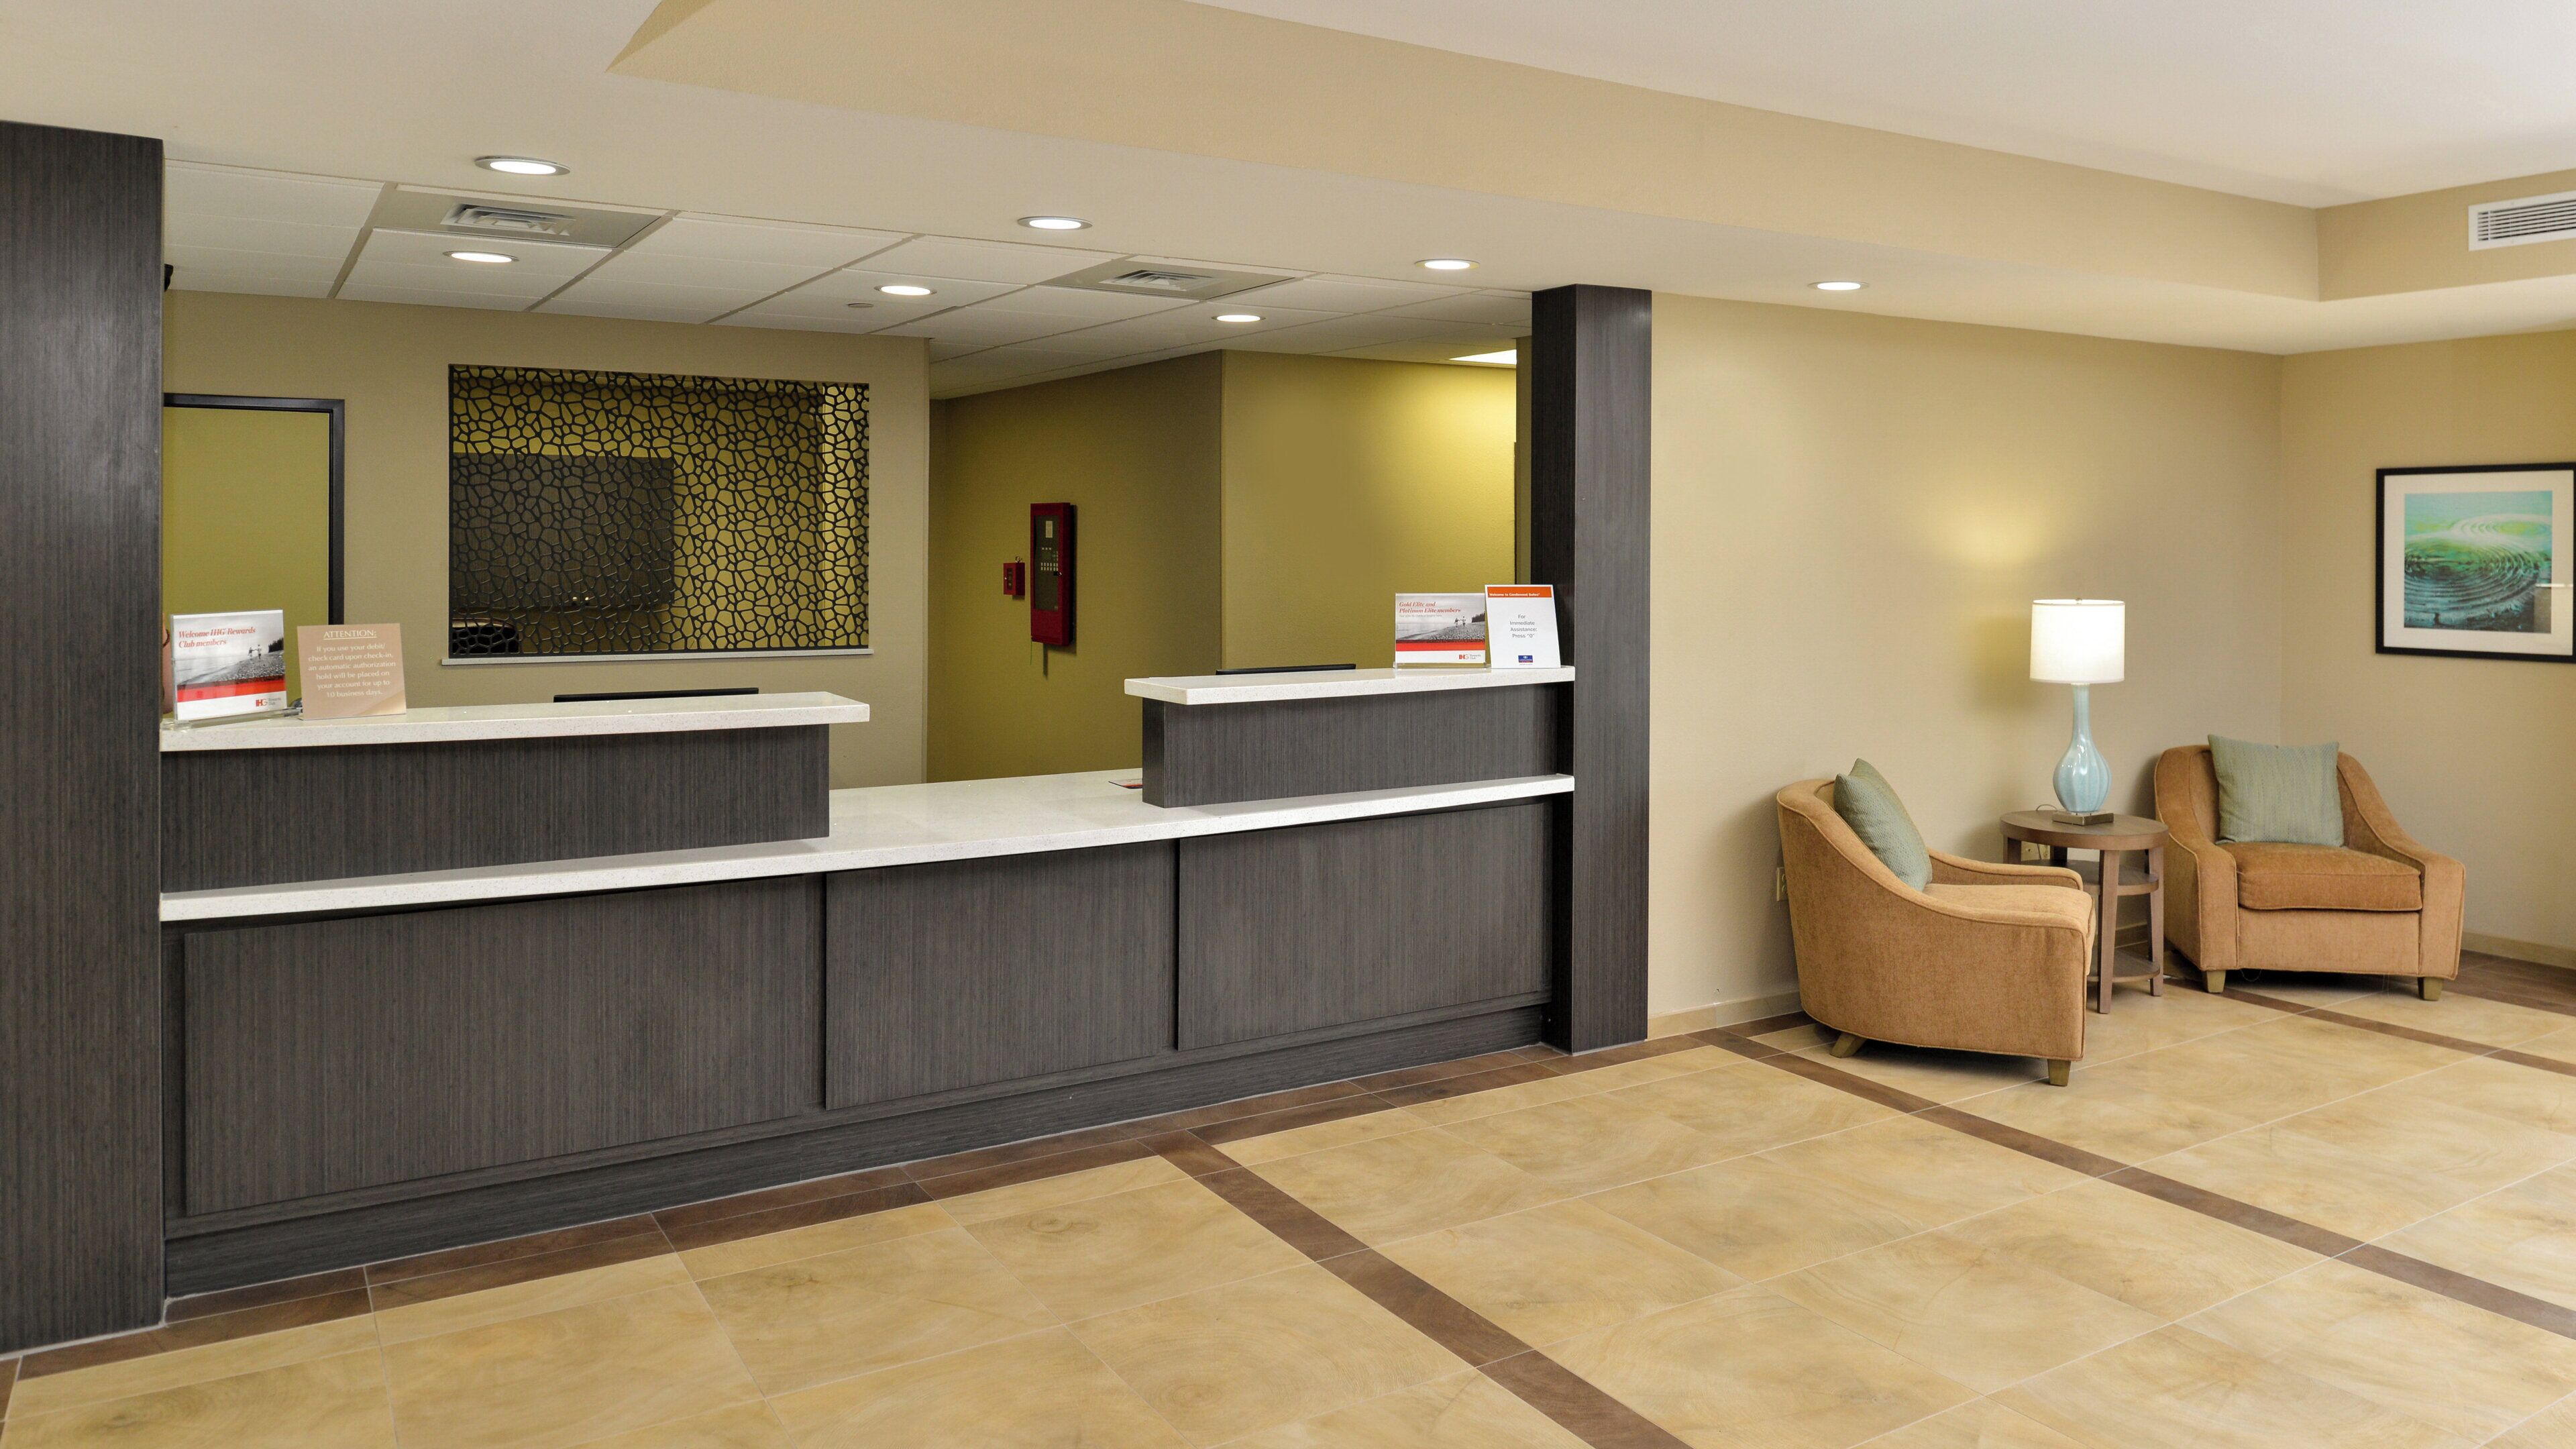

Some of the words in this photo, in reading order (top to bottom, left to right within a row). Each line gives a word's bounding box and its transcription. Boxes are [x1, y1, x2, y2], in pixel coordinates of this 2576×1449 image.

[227, 627, 256, 635] Rewards
[323, 630, 376, 638] ATTENTION:
[178, 640, 195, 648] Club
[196, 639, 227, 647] members
[358, 671, 379, 679] placed
